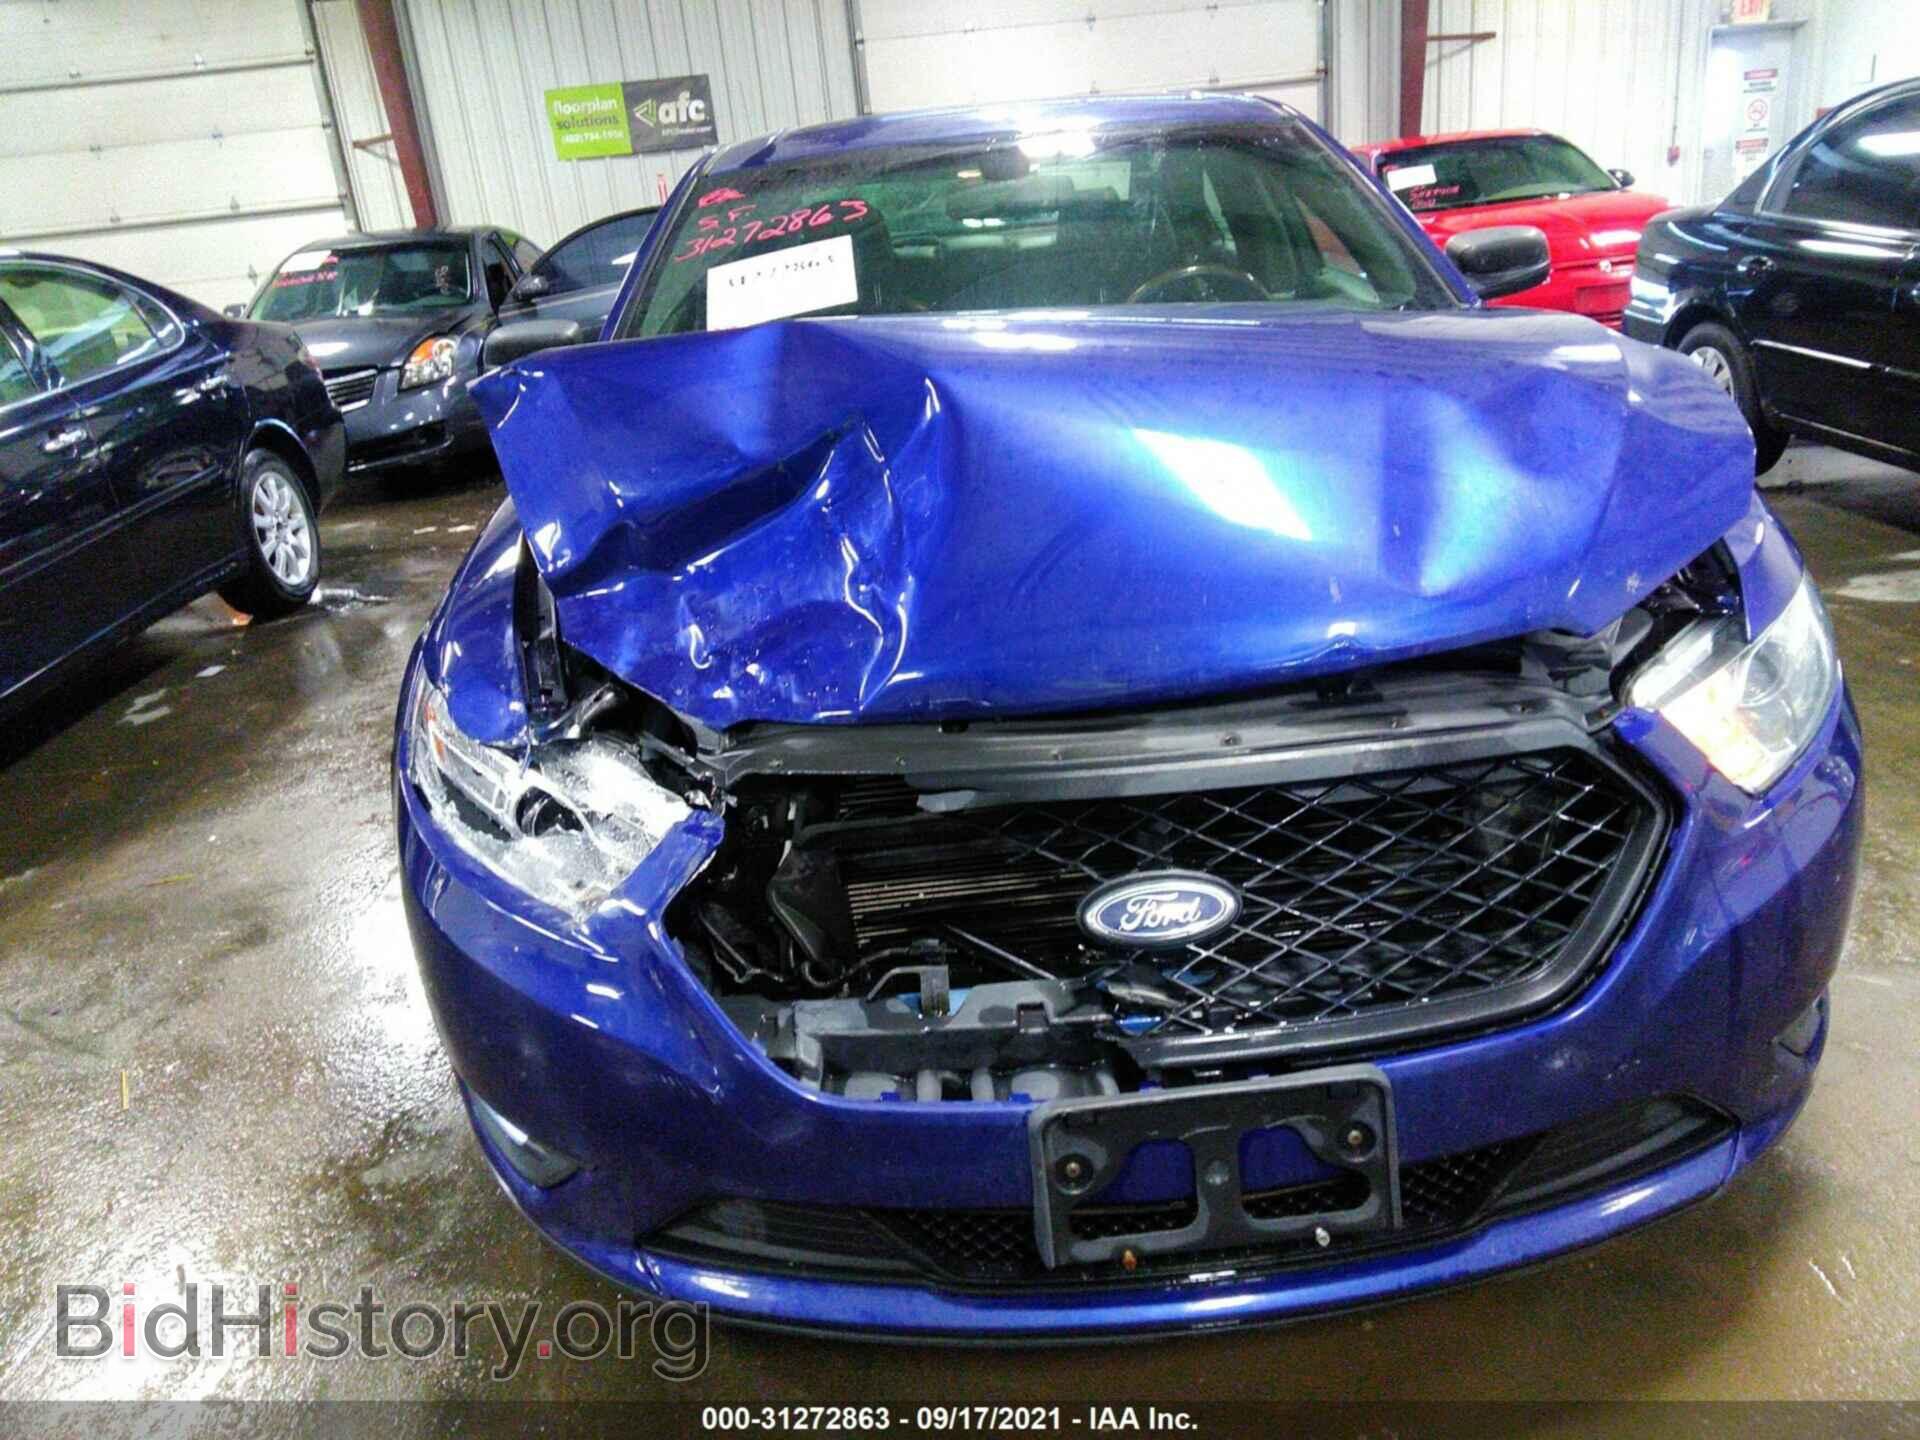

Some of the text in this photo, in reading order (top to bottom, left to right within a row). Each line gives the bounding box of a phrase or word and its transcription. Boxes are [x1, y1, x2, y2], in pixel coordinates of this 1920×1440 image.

[552, 96, 617, 115] floorplan
[556, 113, 619, 130] solutions
[658, 90, 706, 124] afc
[674, 199, 869, 263] 31272863
[1118, 892, 1201, 932] Ford
